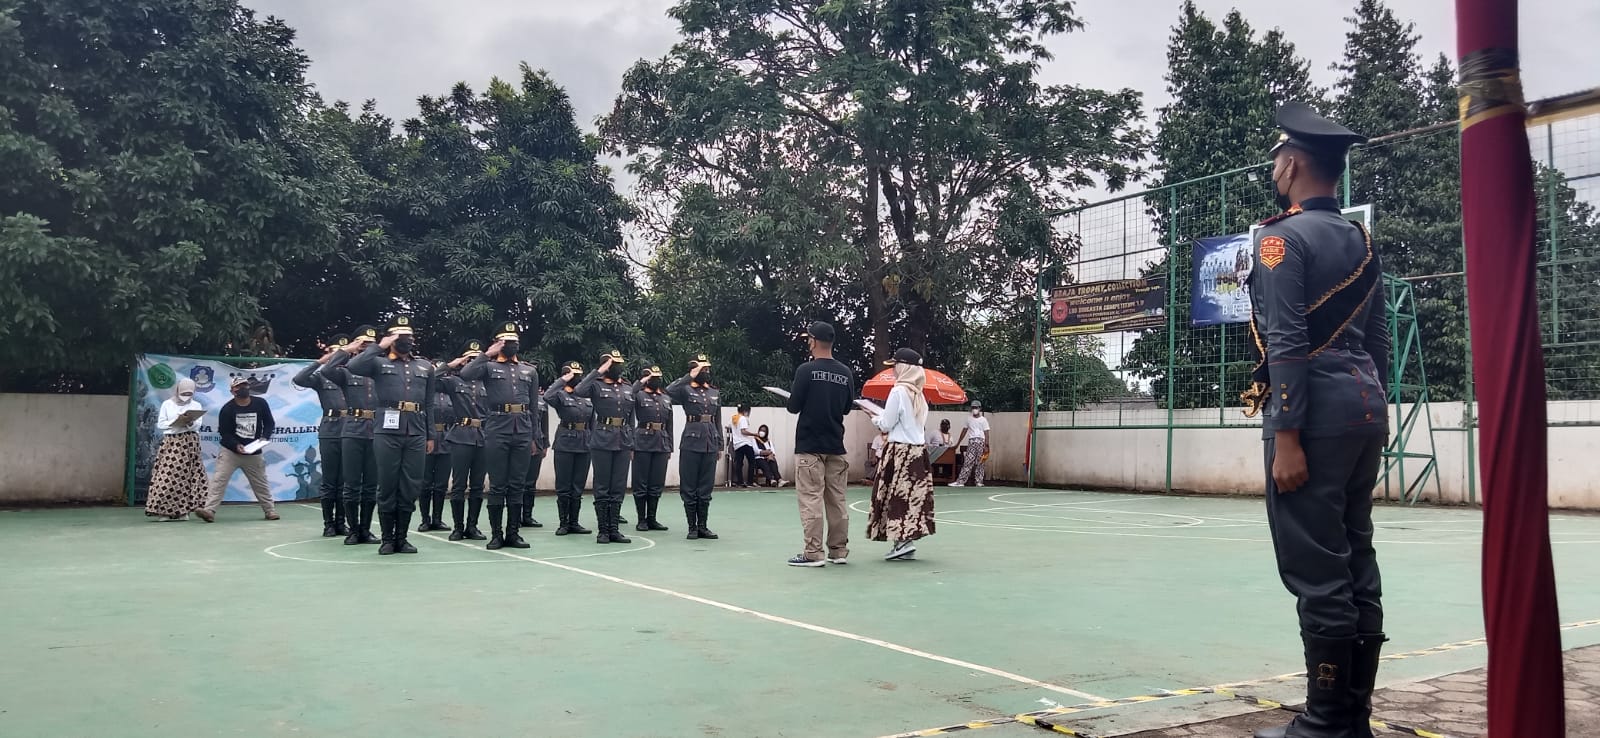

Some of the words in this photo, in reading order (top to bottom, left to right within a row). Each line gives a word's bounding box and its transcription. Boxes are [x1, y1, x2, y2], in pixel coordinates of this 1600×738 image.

[1078, 284, 1105, 296] TROPHY
[1107, 279, 1148, 292] COLLECTION
[811, 370, 826, 381] THE
